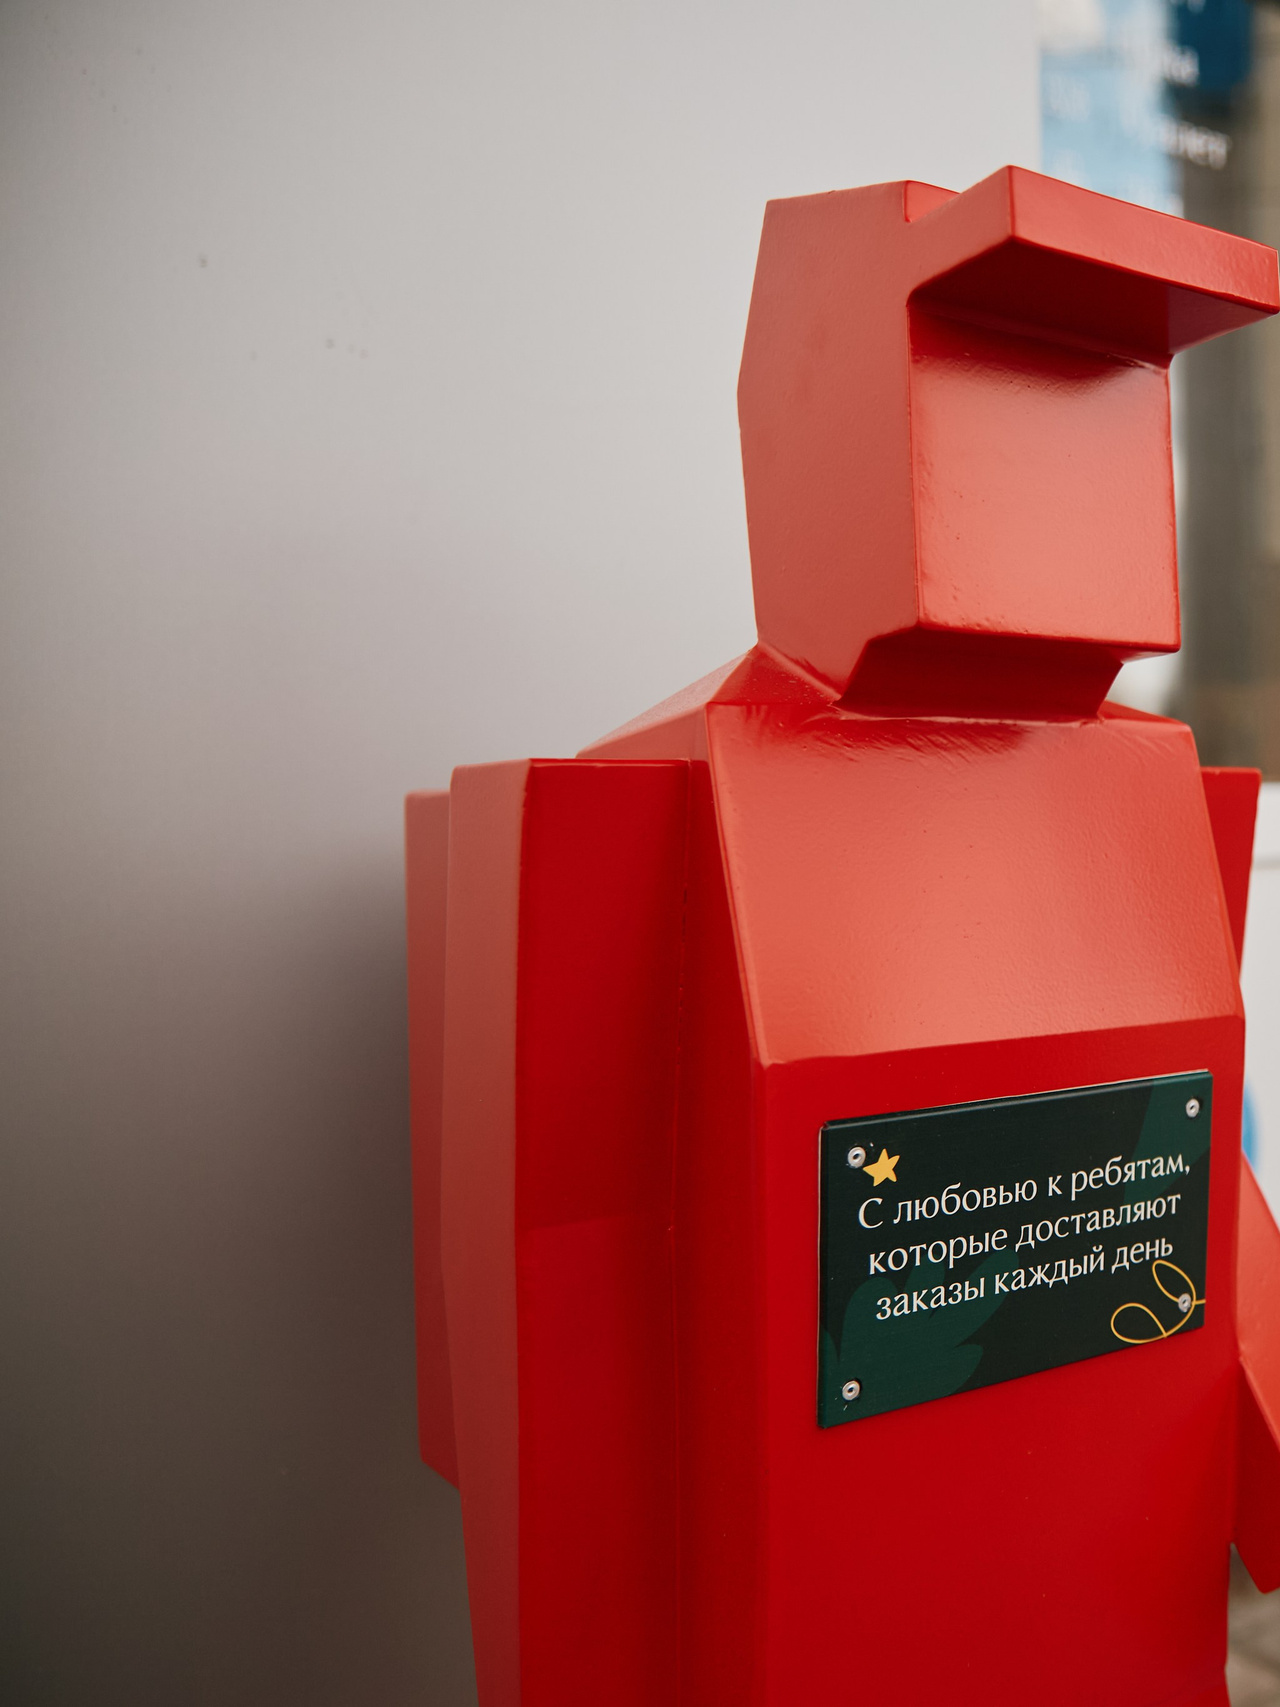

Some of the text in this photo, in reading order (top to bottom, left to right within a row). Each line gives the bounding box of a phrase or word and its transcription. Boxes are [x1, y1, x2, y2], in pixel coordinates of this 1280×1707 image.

[858, 1153, 1191, 1229] С любовью к ребятам,
[869, 1193, 1182, 1275] которые доставляют
[875, 1237, 1174, 1321] заказы каждый день
